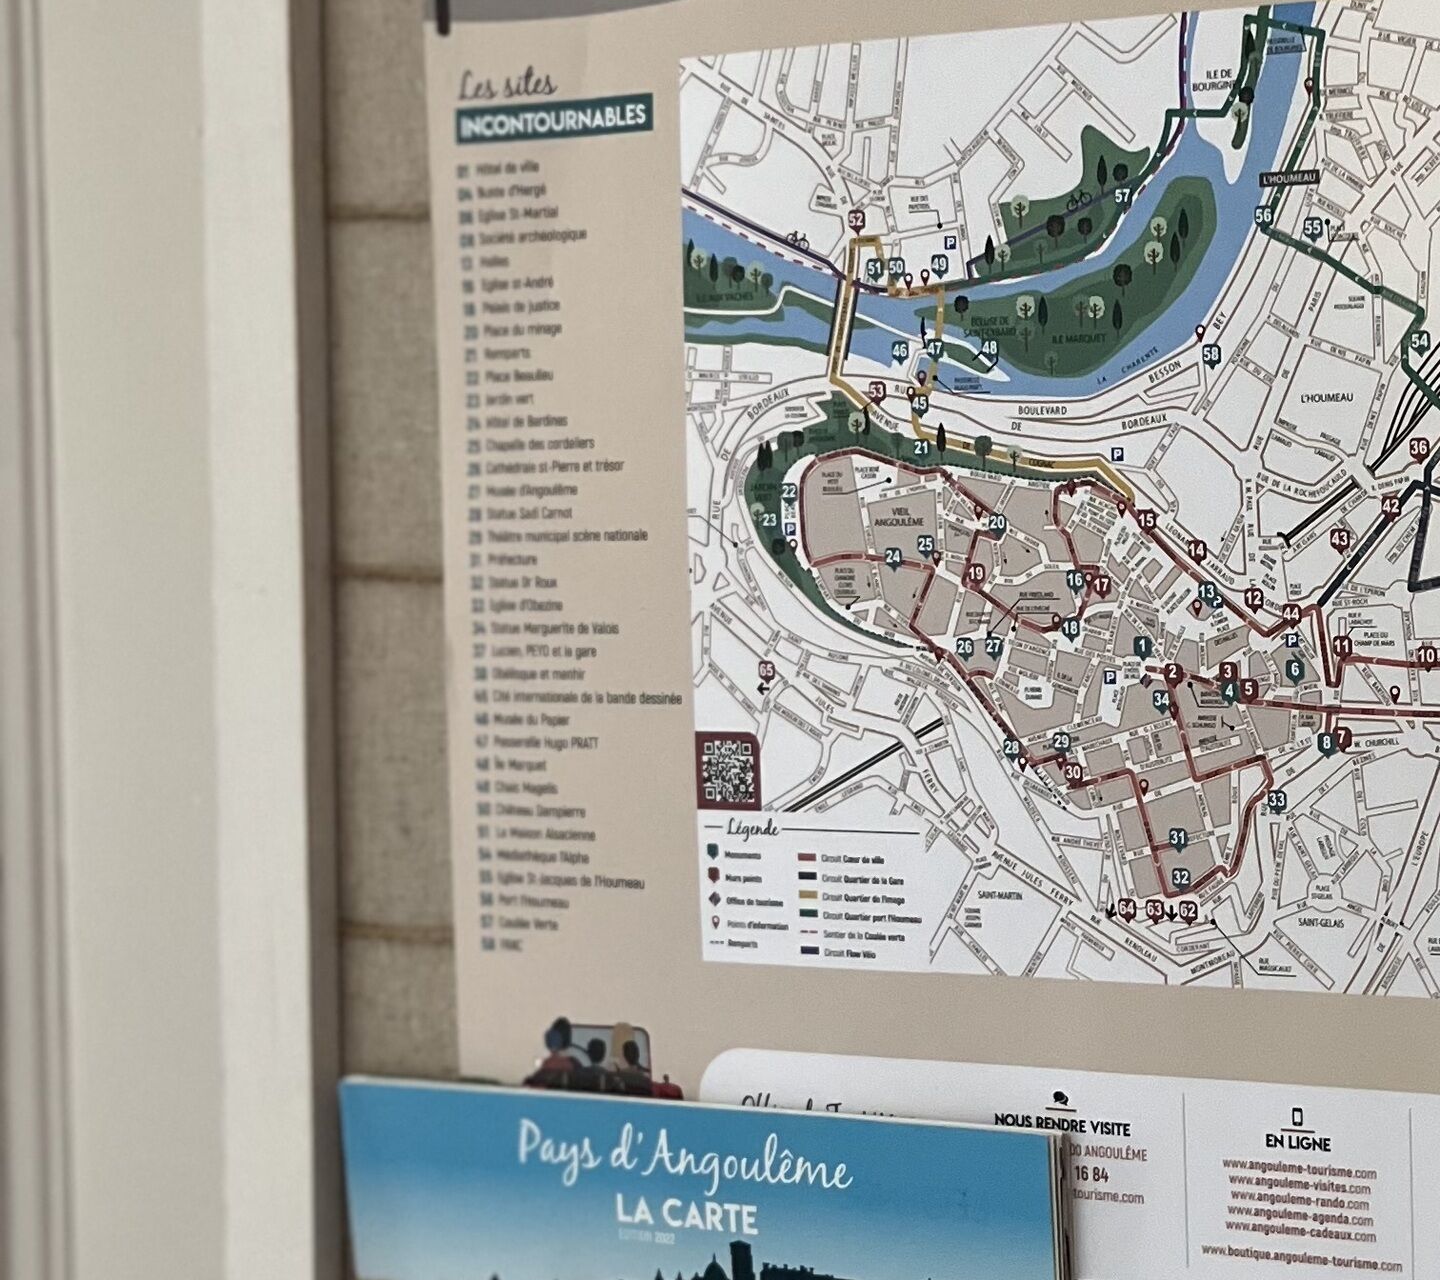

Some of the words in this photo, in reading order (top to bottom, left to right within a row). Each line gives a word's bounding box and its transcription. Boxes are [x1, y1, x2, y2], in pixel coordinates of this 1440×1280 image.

[459, 68, 498, 101] Les
[503, 64, 559, 97] sites
[1206, 70, 1218, 79] ILE
[1220, 69, 1231, 78] DE
[460, 103, 647, 139] INCONTOURNABLES
[1263, 173, 1316, 184] L'HOUMEAU
[1412, 333, 1428, 348] 54
[1204, 347, 1219, 361] 58
[1148, 359, 1182, 384] BESSON
[1301, 393, 1353, 403] L'HOUMEAU
[1018, 406, 1067, 416] BOULEVARD
[1121, 413, 1168, 431] BORDEAUX
[1411, 440, 1427, 454] 36
[874, 515, 925, 527] ANGOULÊME
[892, 507, 910, 516] VIEIL
[1418, 649, 1434, 662] 10
[726, 817, 781, 843] Légende
[1298, 918, 1344, 928] SAINT-GELAIS
[994, 1112, 1033, 1130] NOUS
[1035, 1115, 1087, 1135] RENDRE
[1091, 1119, 1132, 1138] VISITE
[1084, 1143, 1148, 1163] ANGOULÊME
[1265, 1133, 1285, 1149] EN
[1288, 1135, 1332, 1153] LIGNE
[519, 1119, 602, 1186] Pays
[611, 1123, 853, 1196] d'Angoulême
[1074, 1164, 1090, 1182] 16
[1091, 1166, 1110, 1184] 84
[1222, 1158, 1378, 1180] www.angouleme-tourisme.com
[1228, 1174, 1372, 1196] www.angouleme-visites.com
[1230, 1188, 1370, 1211] www.angouleme-rando.com
[617, 1193, 654, 1225] LA
[662, 1198, 758, 1235] CARTE
[1227, 1203, 1375, 1227] www.angouleme-agenda.com
[1225, 1219, 1377, 1244] www.angouleme-cadeaux.com
[1201, 1242, 1403, 1274] www.boutique.angouleme-tourisme.com
